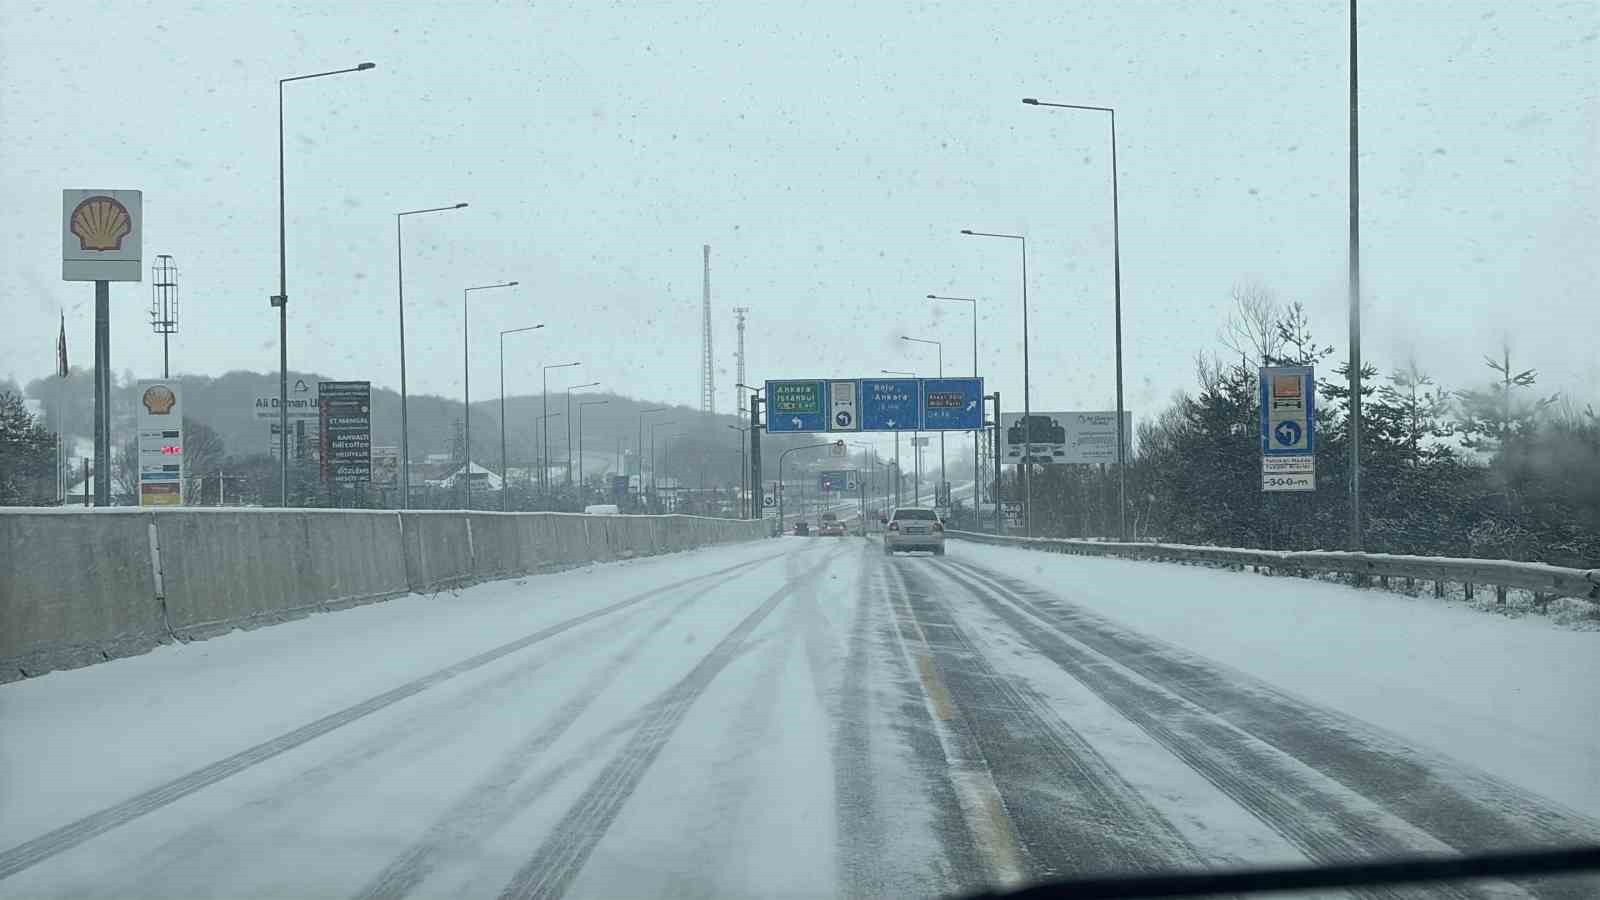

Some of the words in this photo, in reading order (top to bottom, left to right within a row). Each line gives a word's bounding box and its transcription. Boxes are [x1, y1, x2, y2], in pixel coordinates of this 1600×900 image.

[874, 392, 909, 402] Ankara
[255, 397, 269, 408] Ali
[271, 397, 308, 408] Oman
